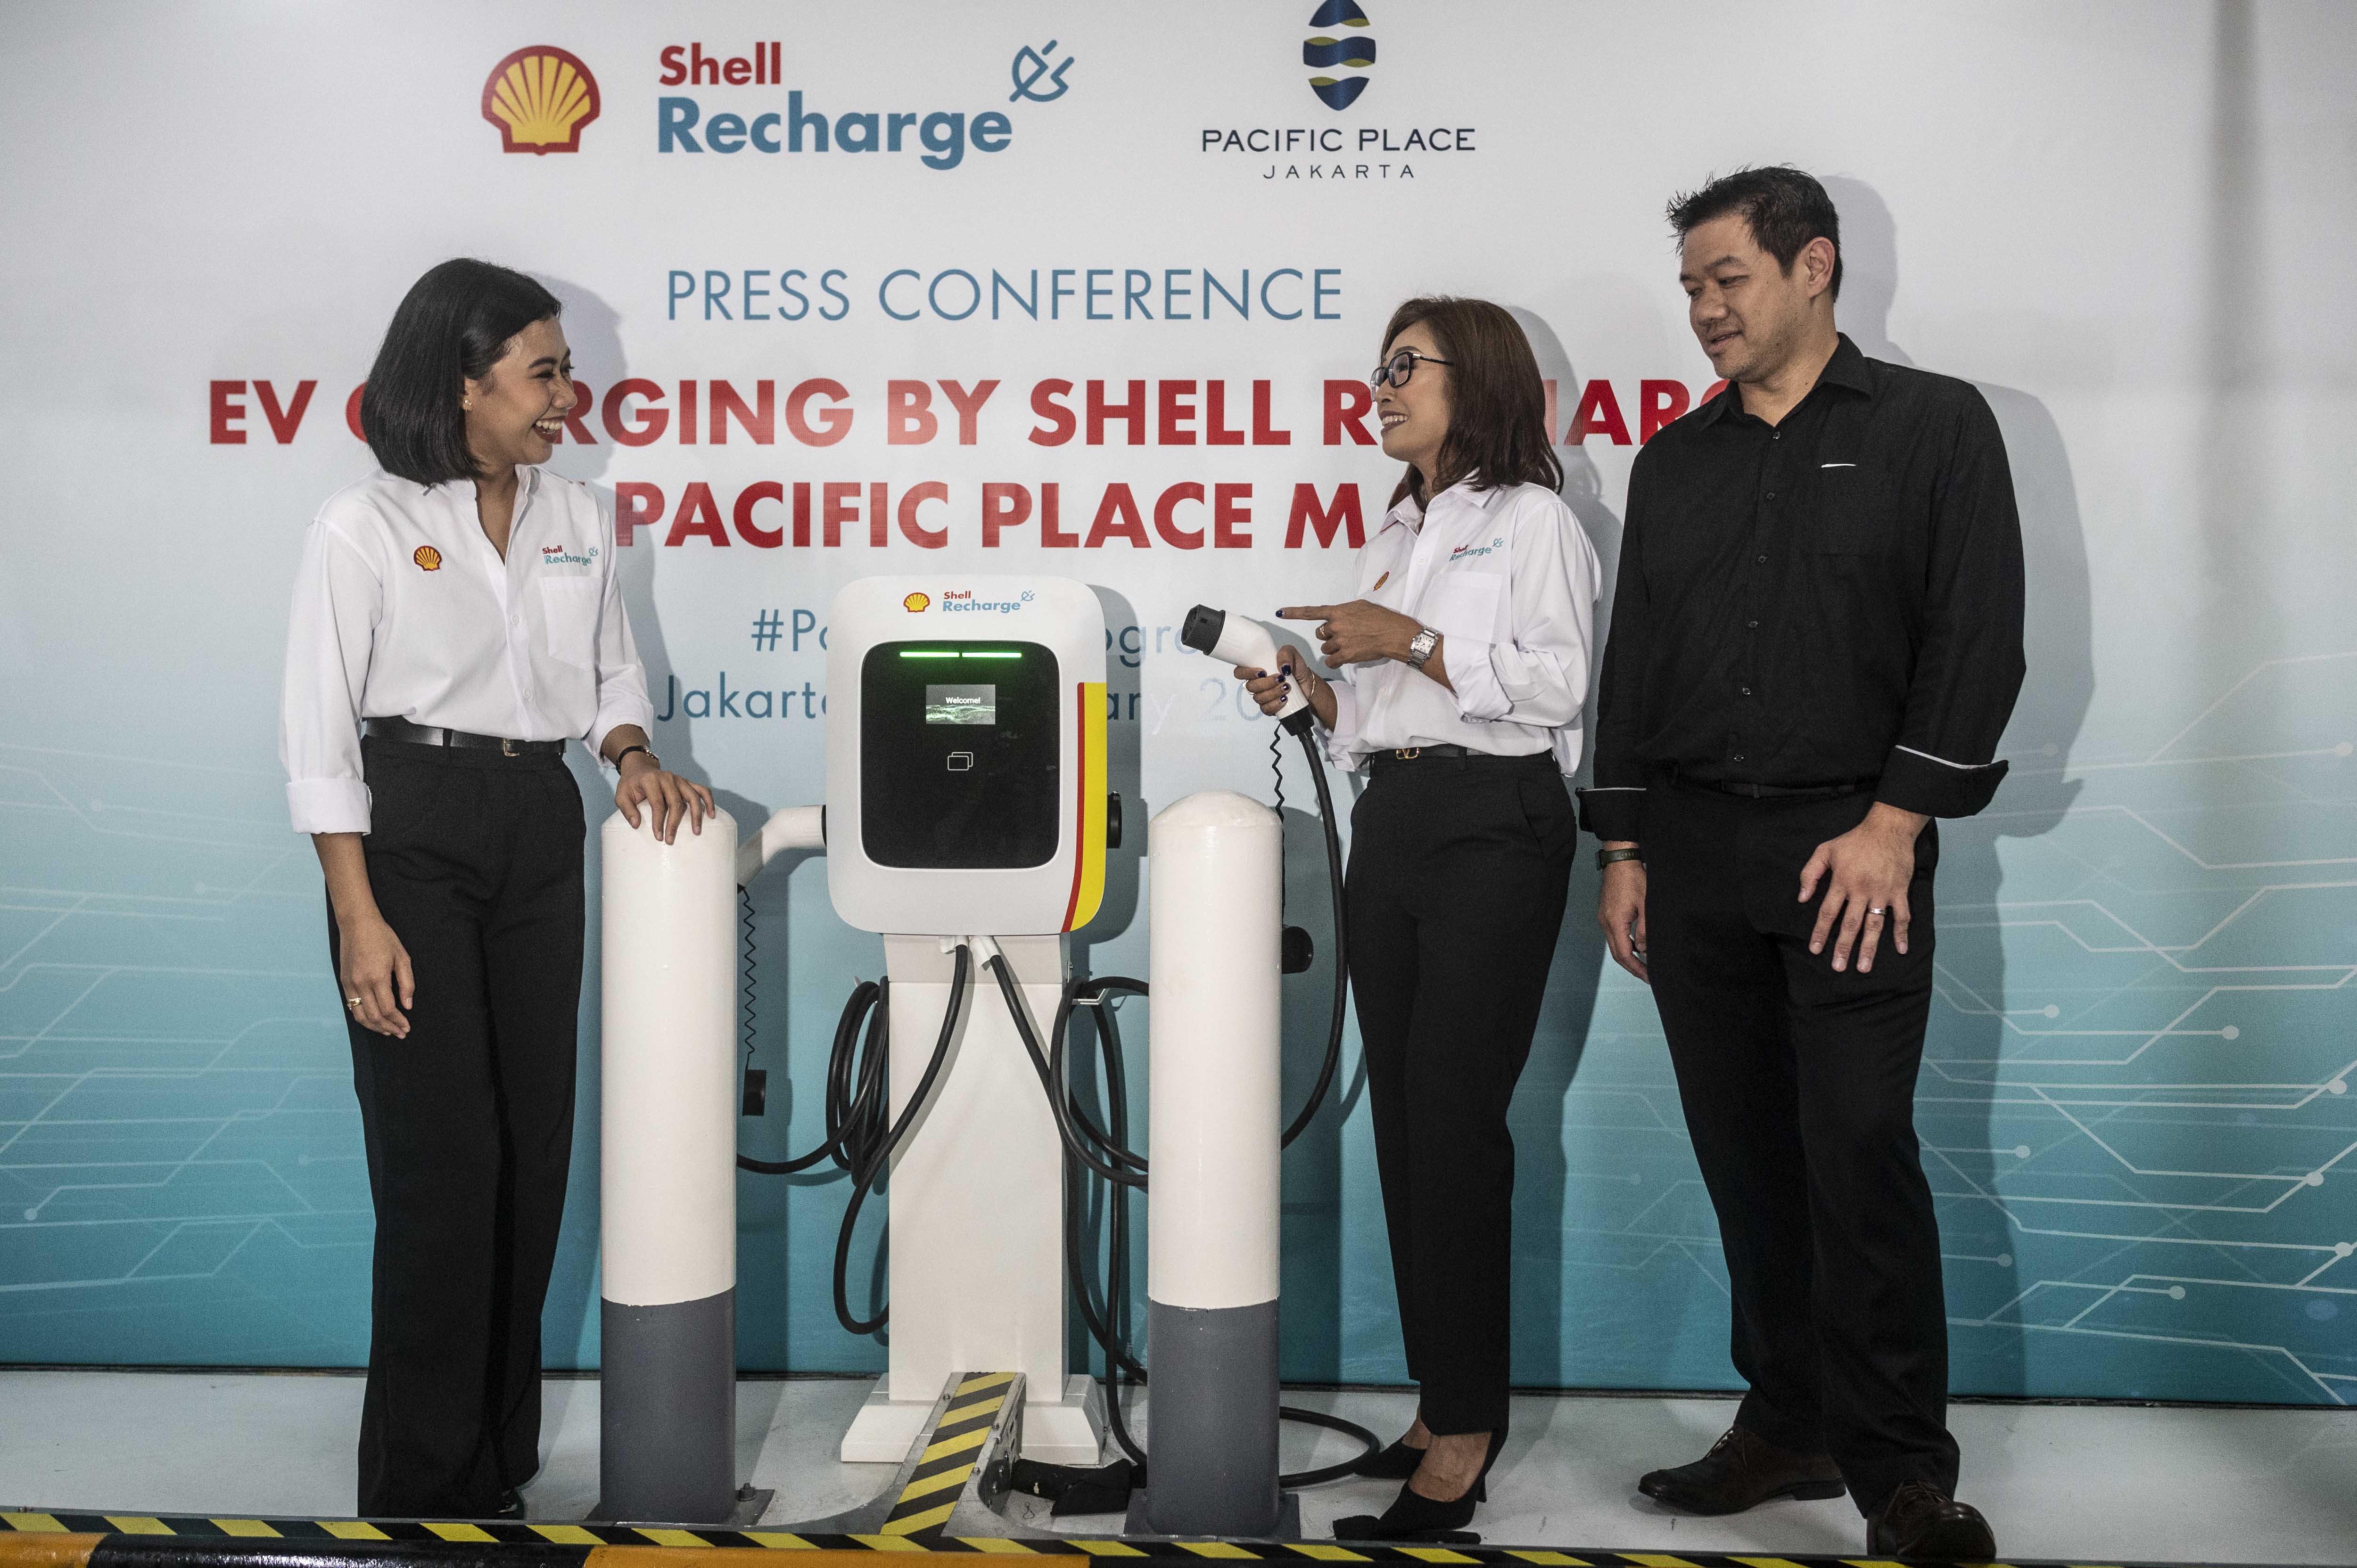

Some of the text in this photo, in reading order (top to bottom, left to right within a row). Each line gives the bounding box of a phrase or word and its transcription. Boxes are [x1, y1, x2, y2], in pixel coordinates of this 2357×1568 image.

[659, 41, 781, 86] Shell
[658, 90, 1012, 171] Recharge
[1202, 128, 1476, 152] PACIFIC PLACE
[1263, 164, 1414, 179] JAKARTA
[668, 268, 1342, 321] PRESS CONFERENCE
[209, 380, 317, 445] EV
[887, 379, 1001, 445] BY
[1028, 378, 1291, 447] SHELL
[616, 481, 948, 549] PACIFIC
[981, 481, 1253, 550] PLACE
[542, 545, 563, 554] Shell
[544, 552, 592, 566] Recharge
[943, 599, 1021, 614] Recharge
[944, 591, 971, 599] Shell
[657, 671, 826, 722] Jakart
